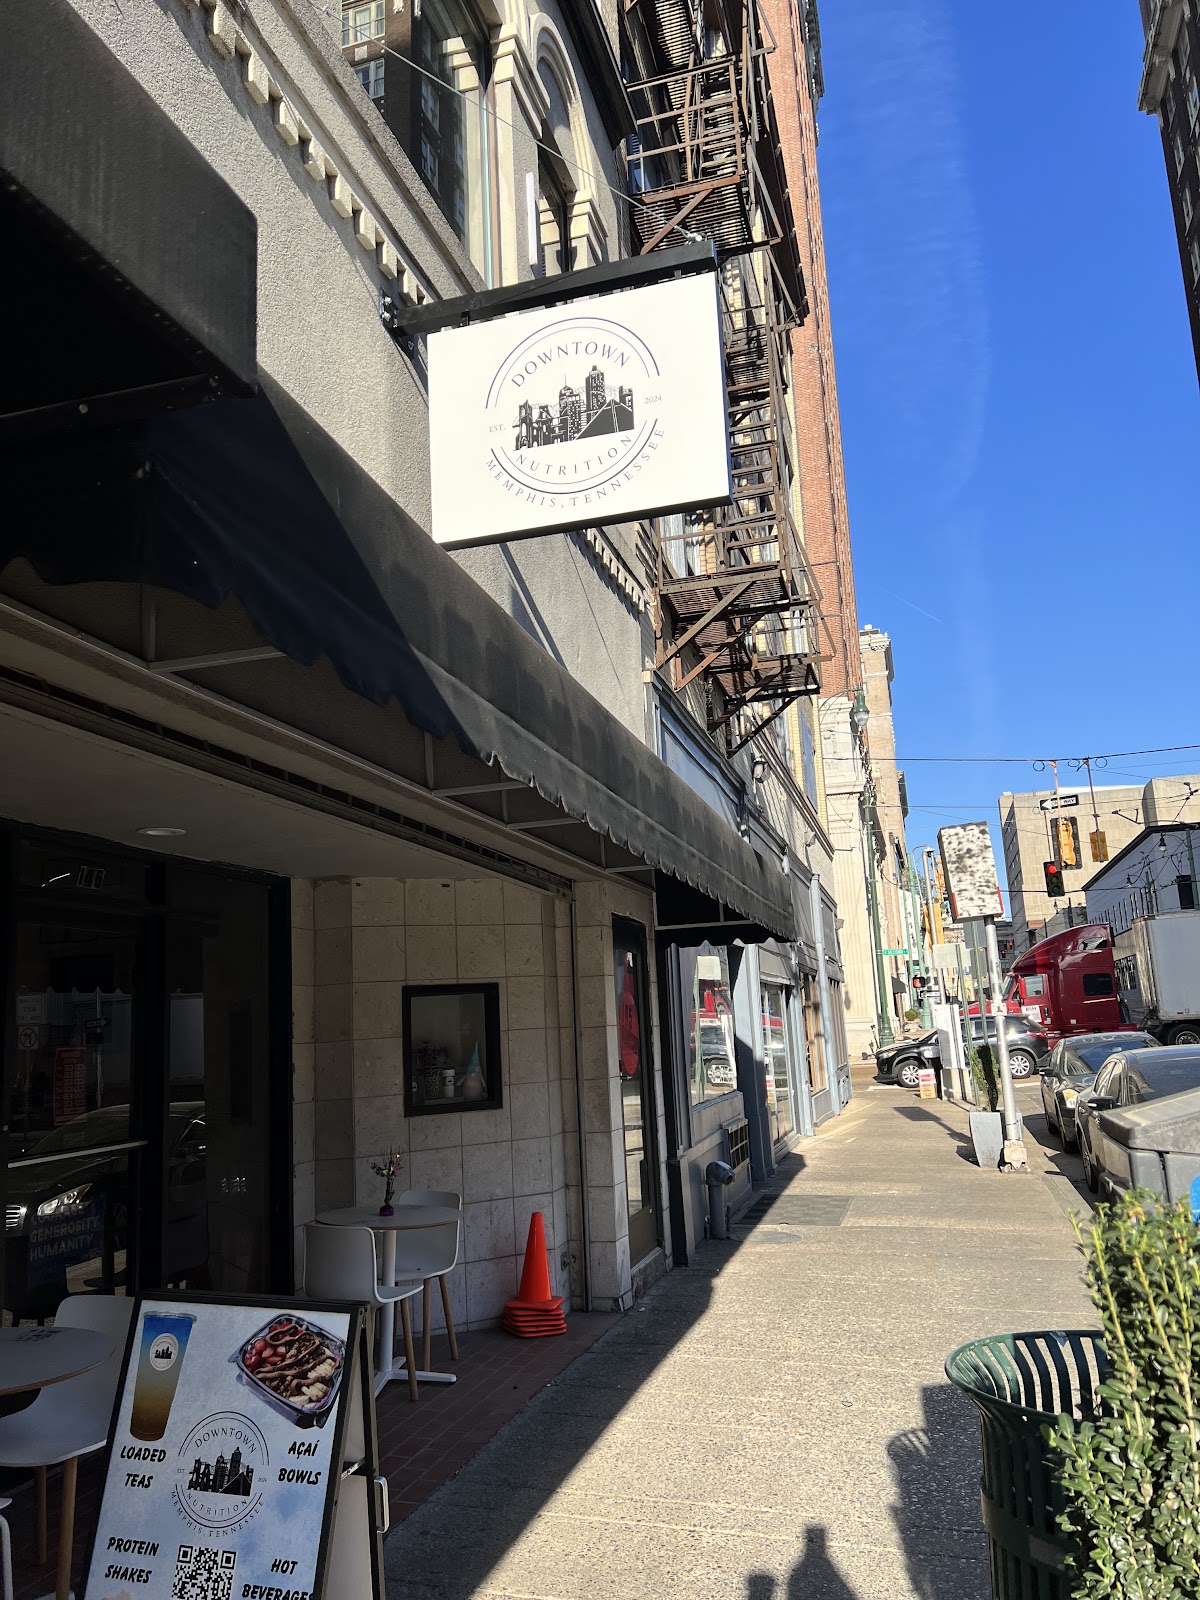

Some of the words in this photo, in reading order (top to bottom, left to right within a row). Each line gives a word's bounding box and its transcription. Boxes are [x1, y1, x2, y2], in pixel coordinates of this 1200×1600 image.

[511, 341, 631, 387] DOWNTOWN
[644, 395, 662, 404] 2024
[489, 424, 506, 433] EST.
[515, 435, 632, 476] NUTRITION
[31, 1215, 100, 1243] GENEROSITY
[30, 1233, 94, 1262] HUMANITY
[194, 1427, 257, 1453] DOWNTOWN
[288, 1440, 320, 1460] AÇAÍ
[120, 1446, 166, 1462] LOADED
[125, 1473, 153, 1488] TEAS
[278, 1468, 321, 1485] BOWLS
[187, 1493, 247, 1515] NUTRITION
[107, 1536, 160, 1556] PROTEIN
[105, 1564, 152, 1583] SHAKES
[271, 1558, 298, 1575] HOT
